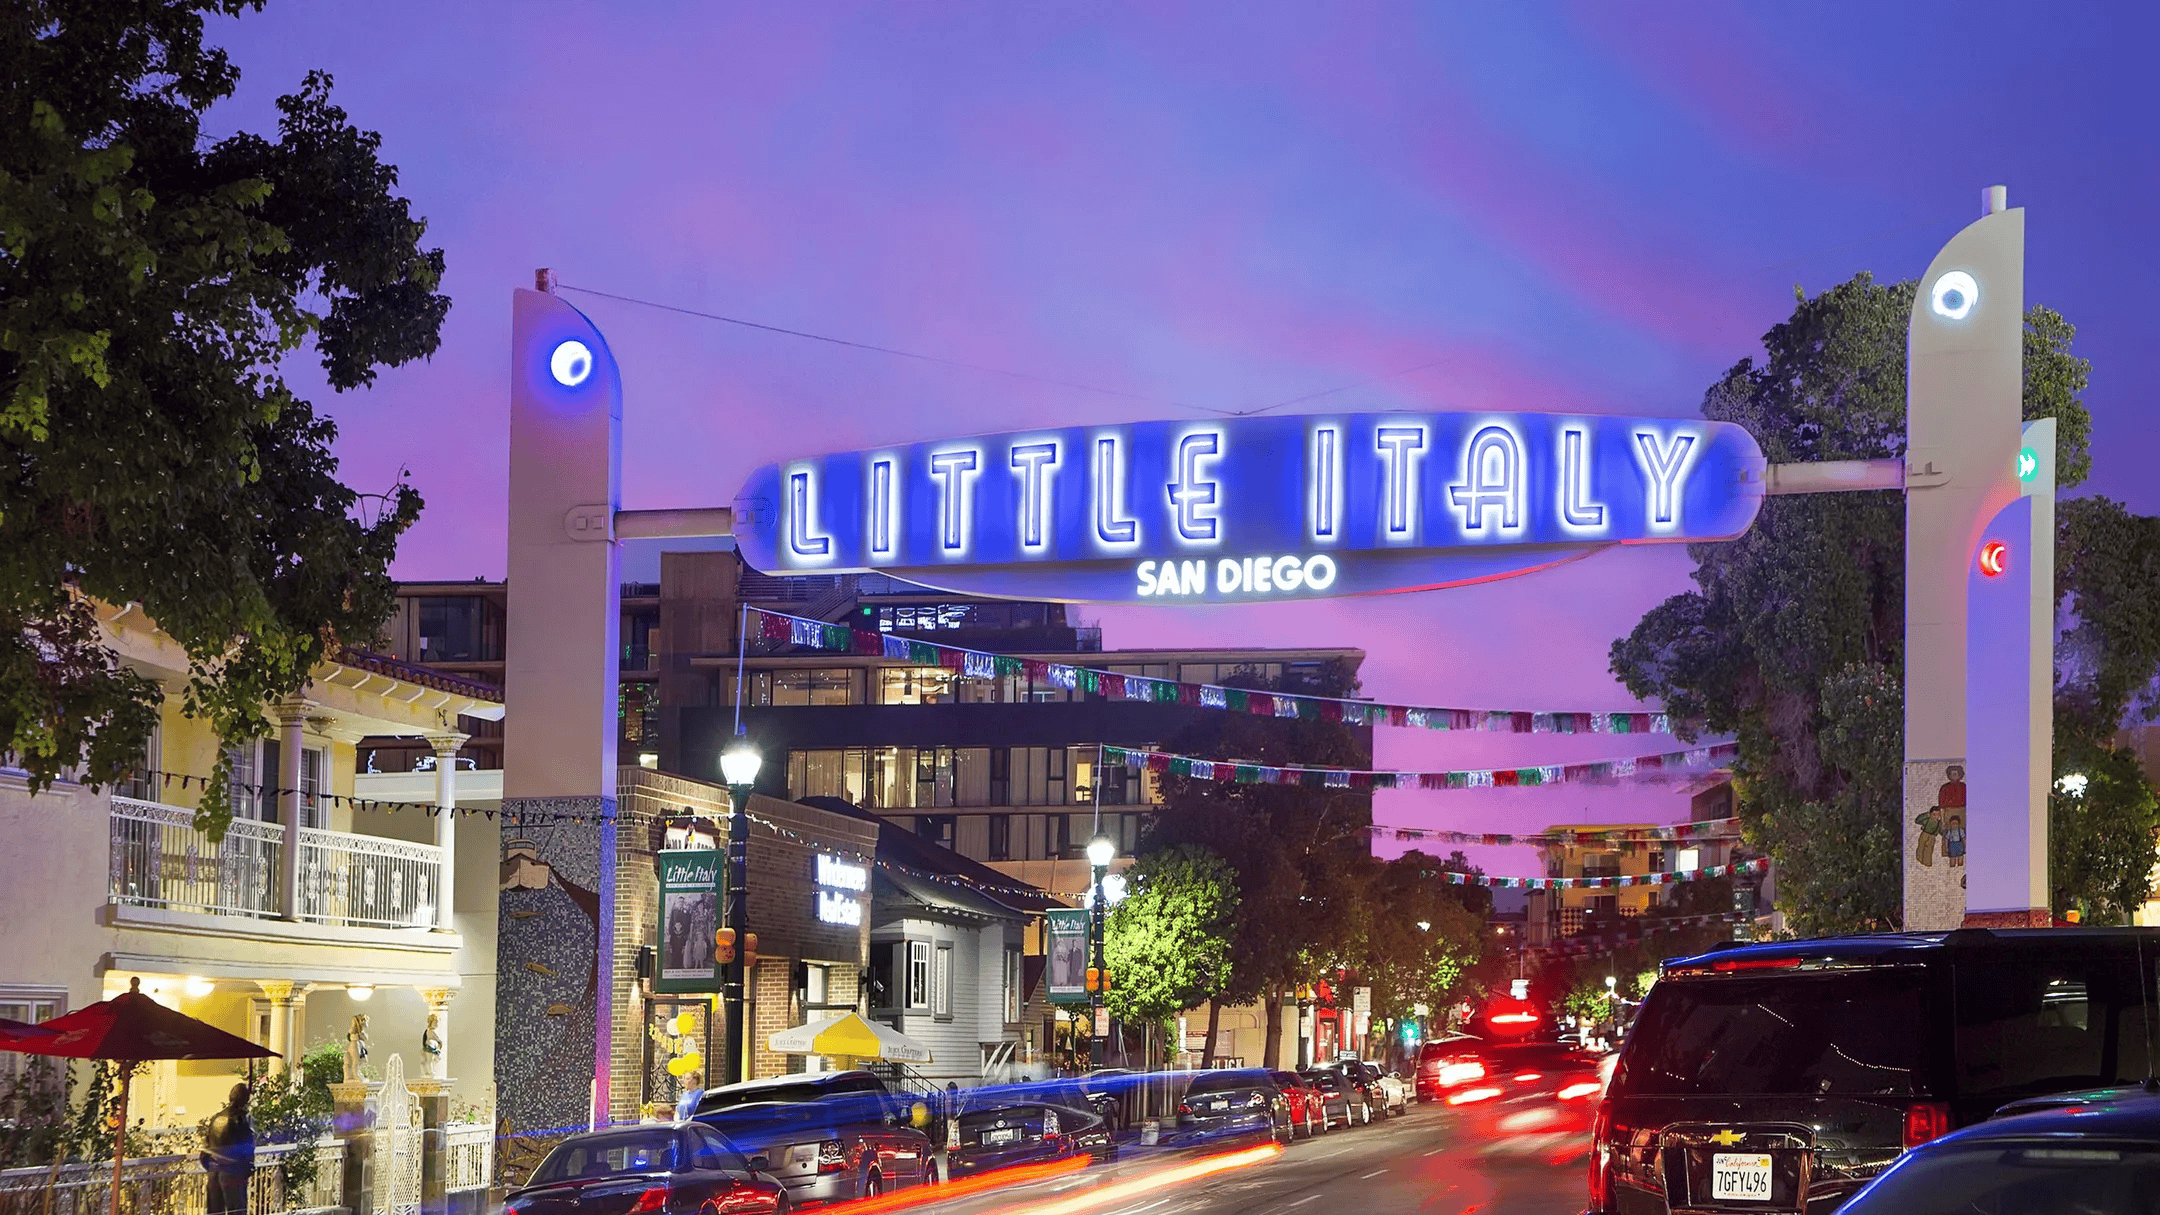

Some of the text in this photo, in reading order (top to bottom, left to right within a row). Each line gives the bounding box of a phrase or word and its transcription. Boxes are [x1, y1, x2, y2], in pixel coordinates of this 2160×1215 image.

[789, 425, 1695, 556] LITTLE ITALY
[1137, 554, 1337, 596] SAN DIEGO
[666, 857, 718, 891] Little Italy
[1717, 1171, 1767, 1192] 7GFY496
